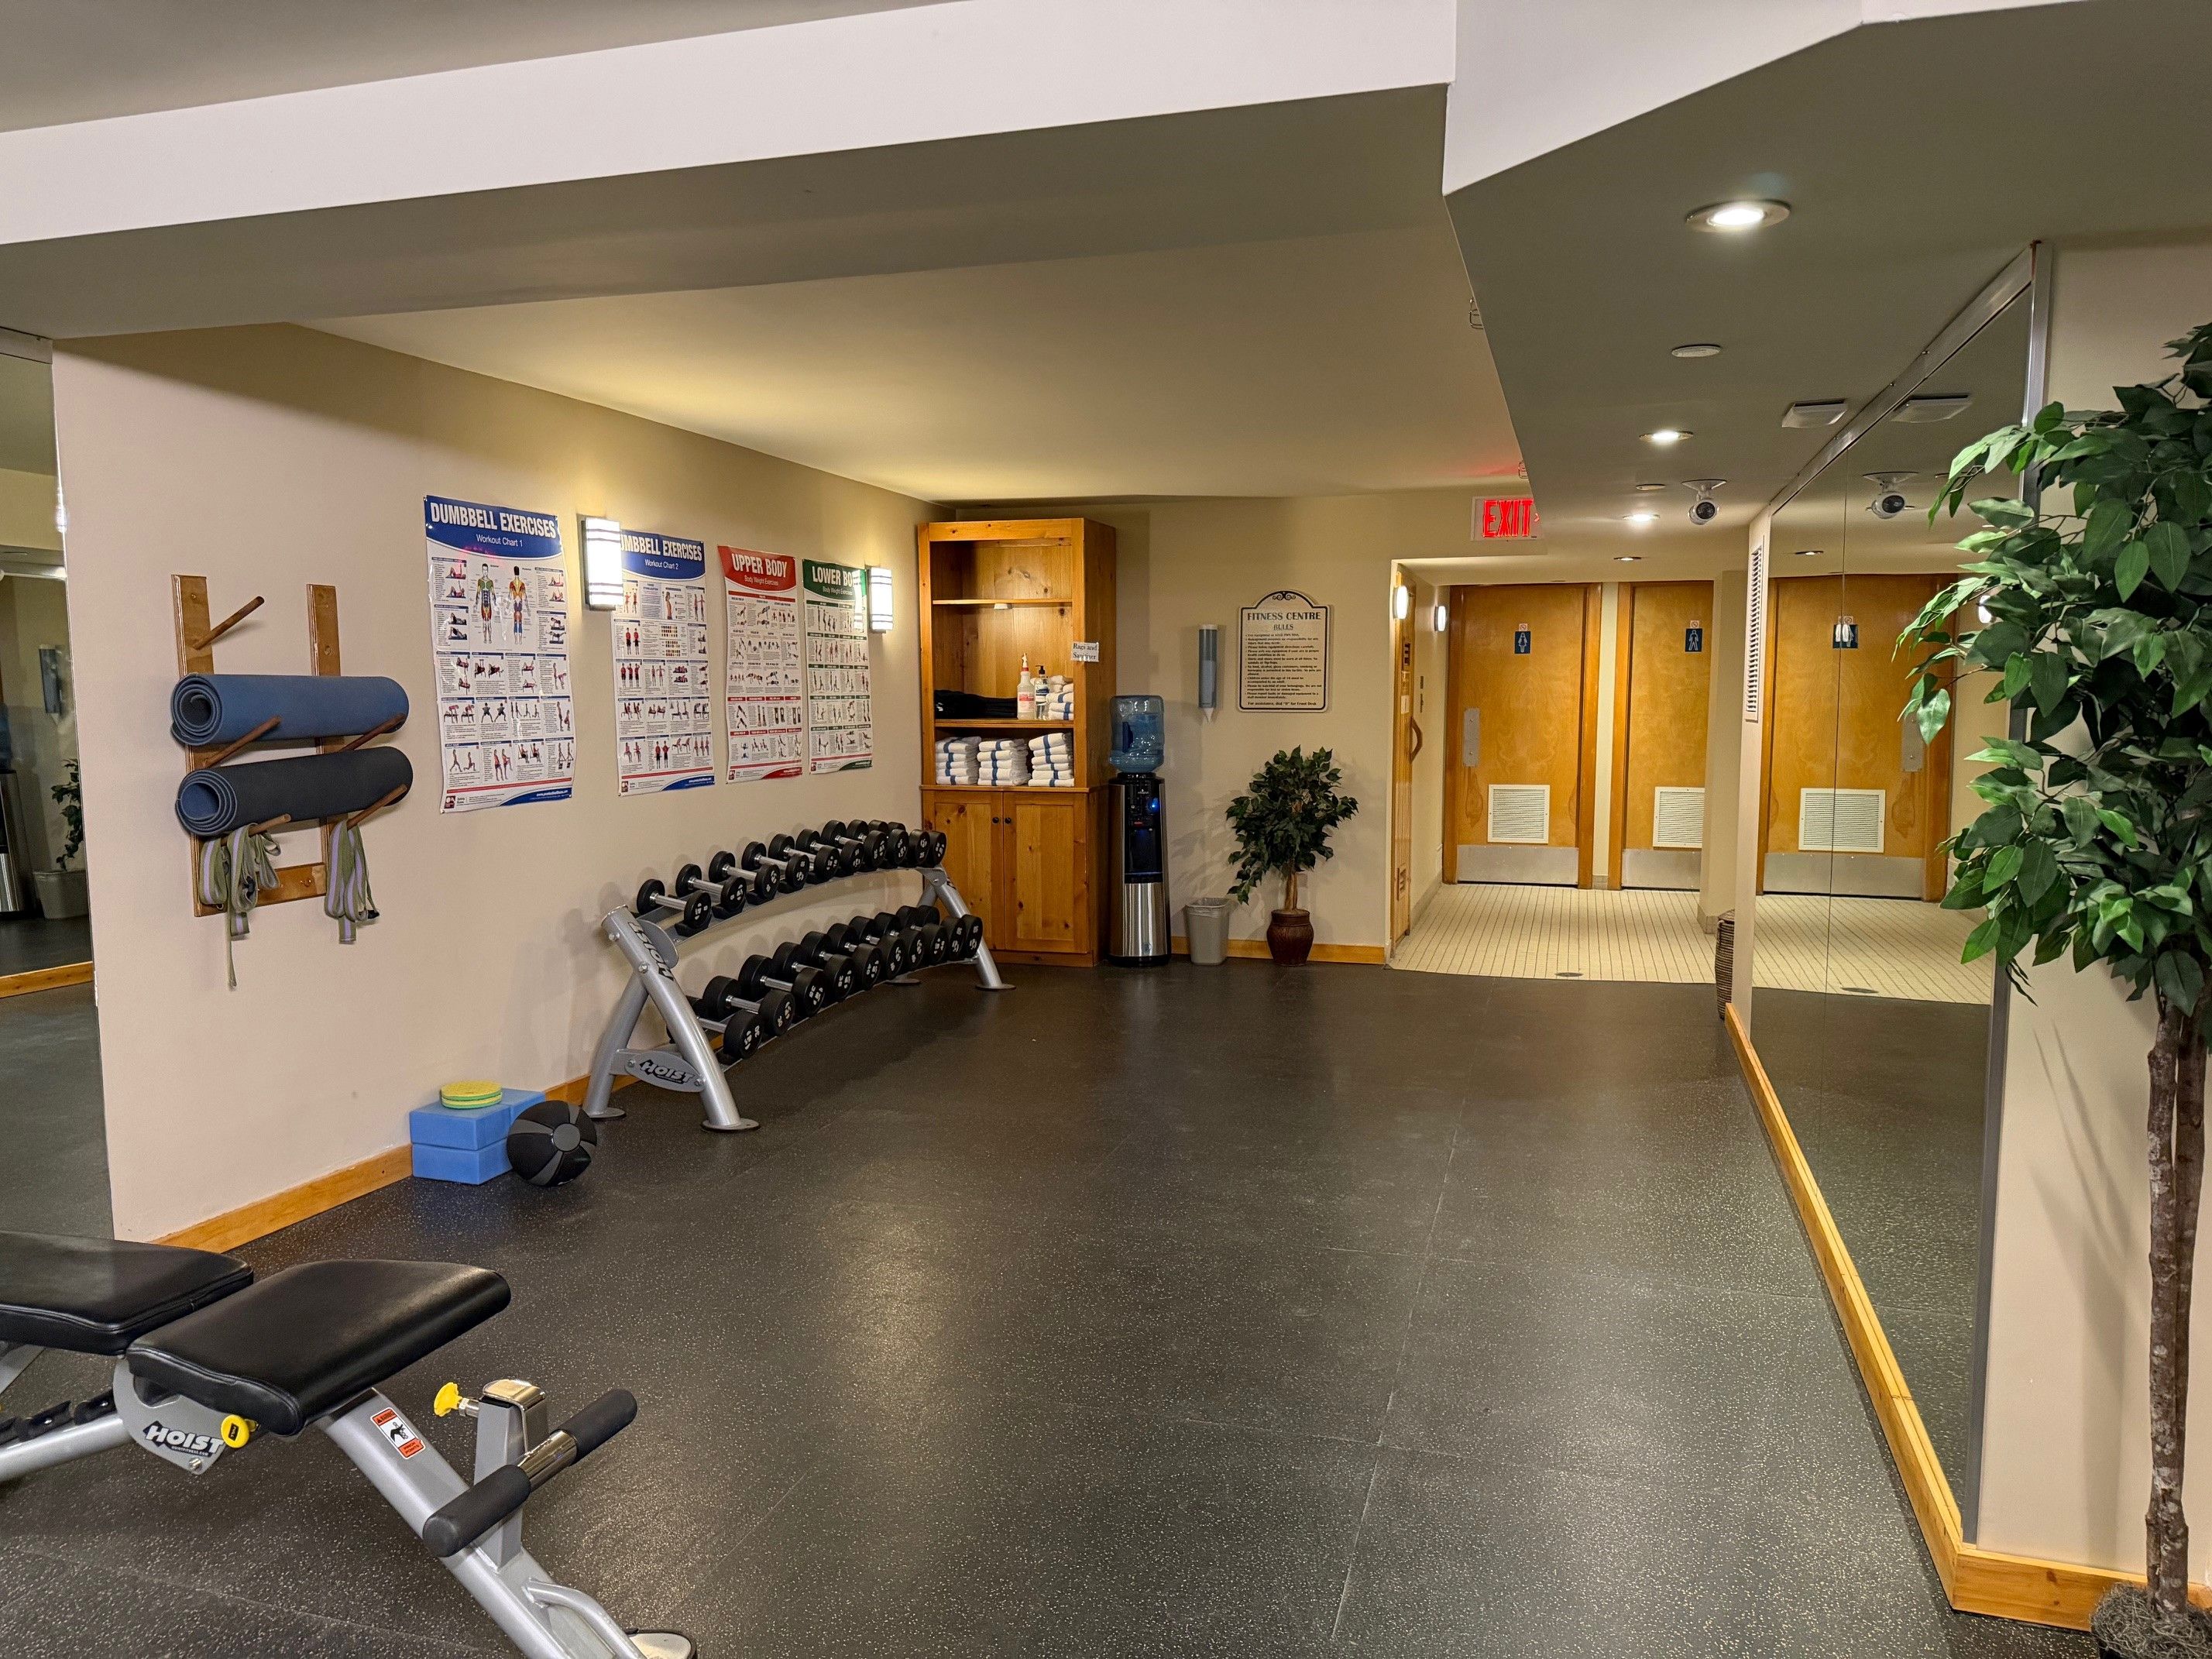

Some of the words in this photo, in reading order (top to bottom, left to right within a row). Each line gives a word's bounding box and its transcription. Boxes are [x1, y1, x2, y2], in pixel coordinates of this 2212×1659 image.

[430, 502, 498, 531] DUMBBELL
[500, 512, 557, 539] EXERCISES
[1482, 498, 1534, 538] EXIT
[476, 534, 501, 545] Workout
[503, 538, 518, 547] Chart
[620, 534, 661, 555] UMBBELL
[662, 540, 702, 562] EXERCISES
[644, 558, 663, 568] Workout
[731, 553, 764, 575] UPPER
[765, 558, 788, 578] BODY
[744, 575, 754, 583] Body
[754, 577, 764, 586] Weight
[764, 578, 779, 586] Exercises
[812, 566, 841, 586] LOWER
[843, 571, 854, 587] BO
[1286, 612, 1321, 620] CENTRE
[627, 922, 675, 979] HOIST
[641, 1060, 696, 1083] HOIST
[145, 1425, 225, 1454] HOIST
